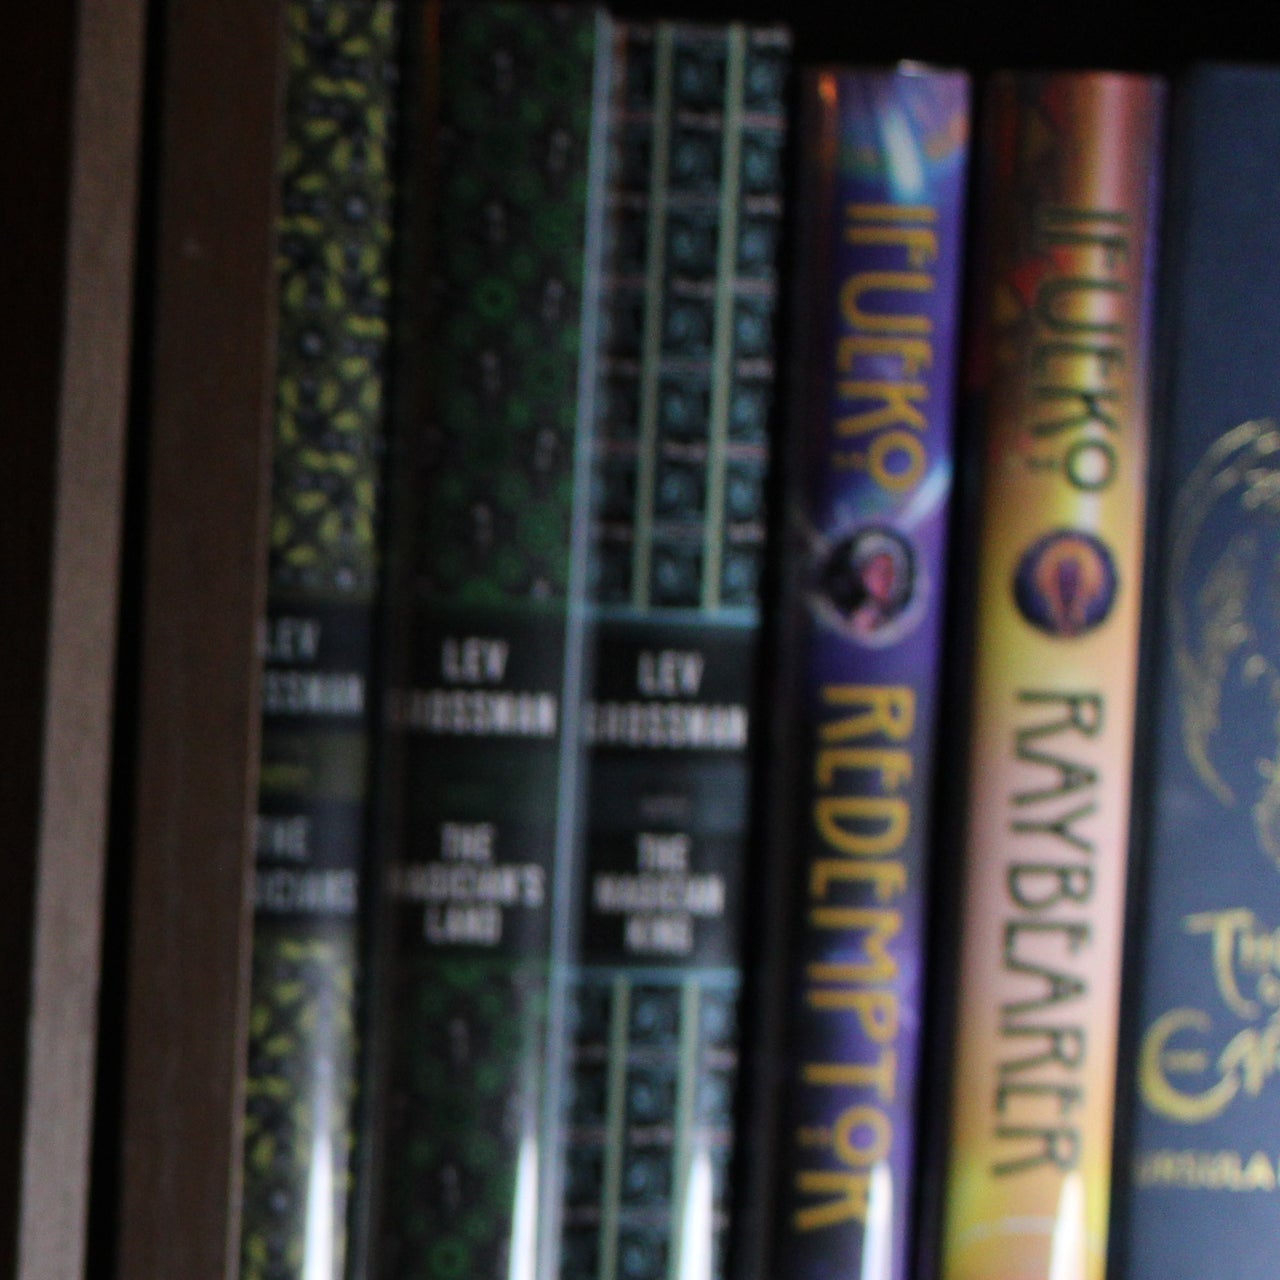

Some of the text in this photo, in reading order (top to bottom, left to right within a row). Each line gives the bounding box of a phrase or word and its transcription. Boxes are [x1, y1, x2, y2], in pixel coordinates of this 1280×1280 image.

[830, 203, 938, 494] IFUEKO
[1028, 207, 1130, 492] IFUEKO
[442, 636, 510, 684] LEV
[638, 650, 704, 697] LEV
[442, 822, 496, 861] THE
[636, 831, 690, 872] THE
[791, 684, 916, 1233] REDEMPTOR
[991, 689, 1104, 1177] RAYBEARER
